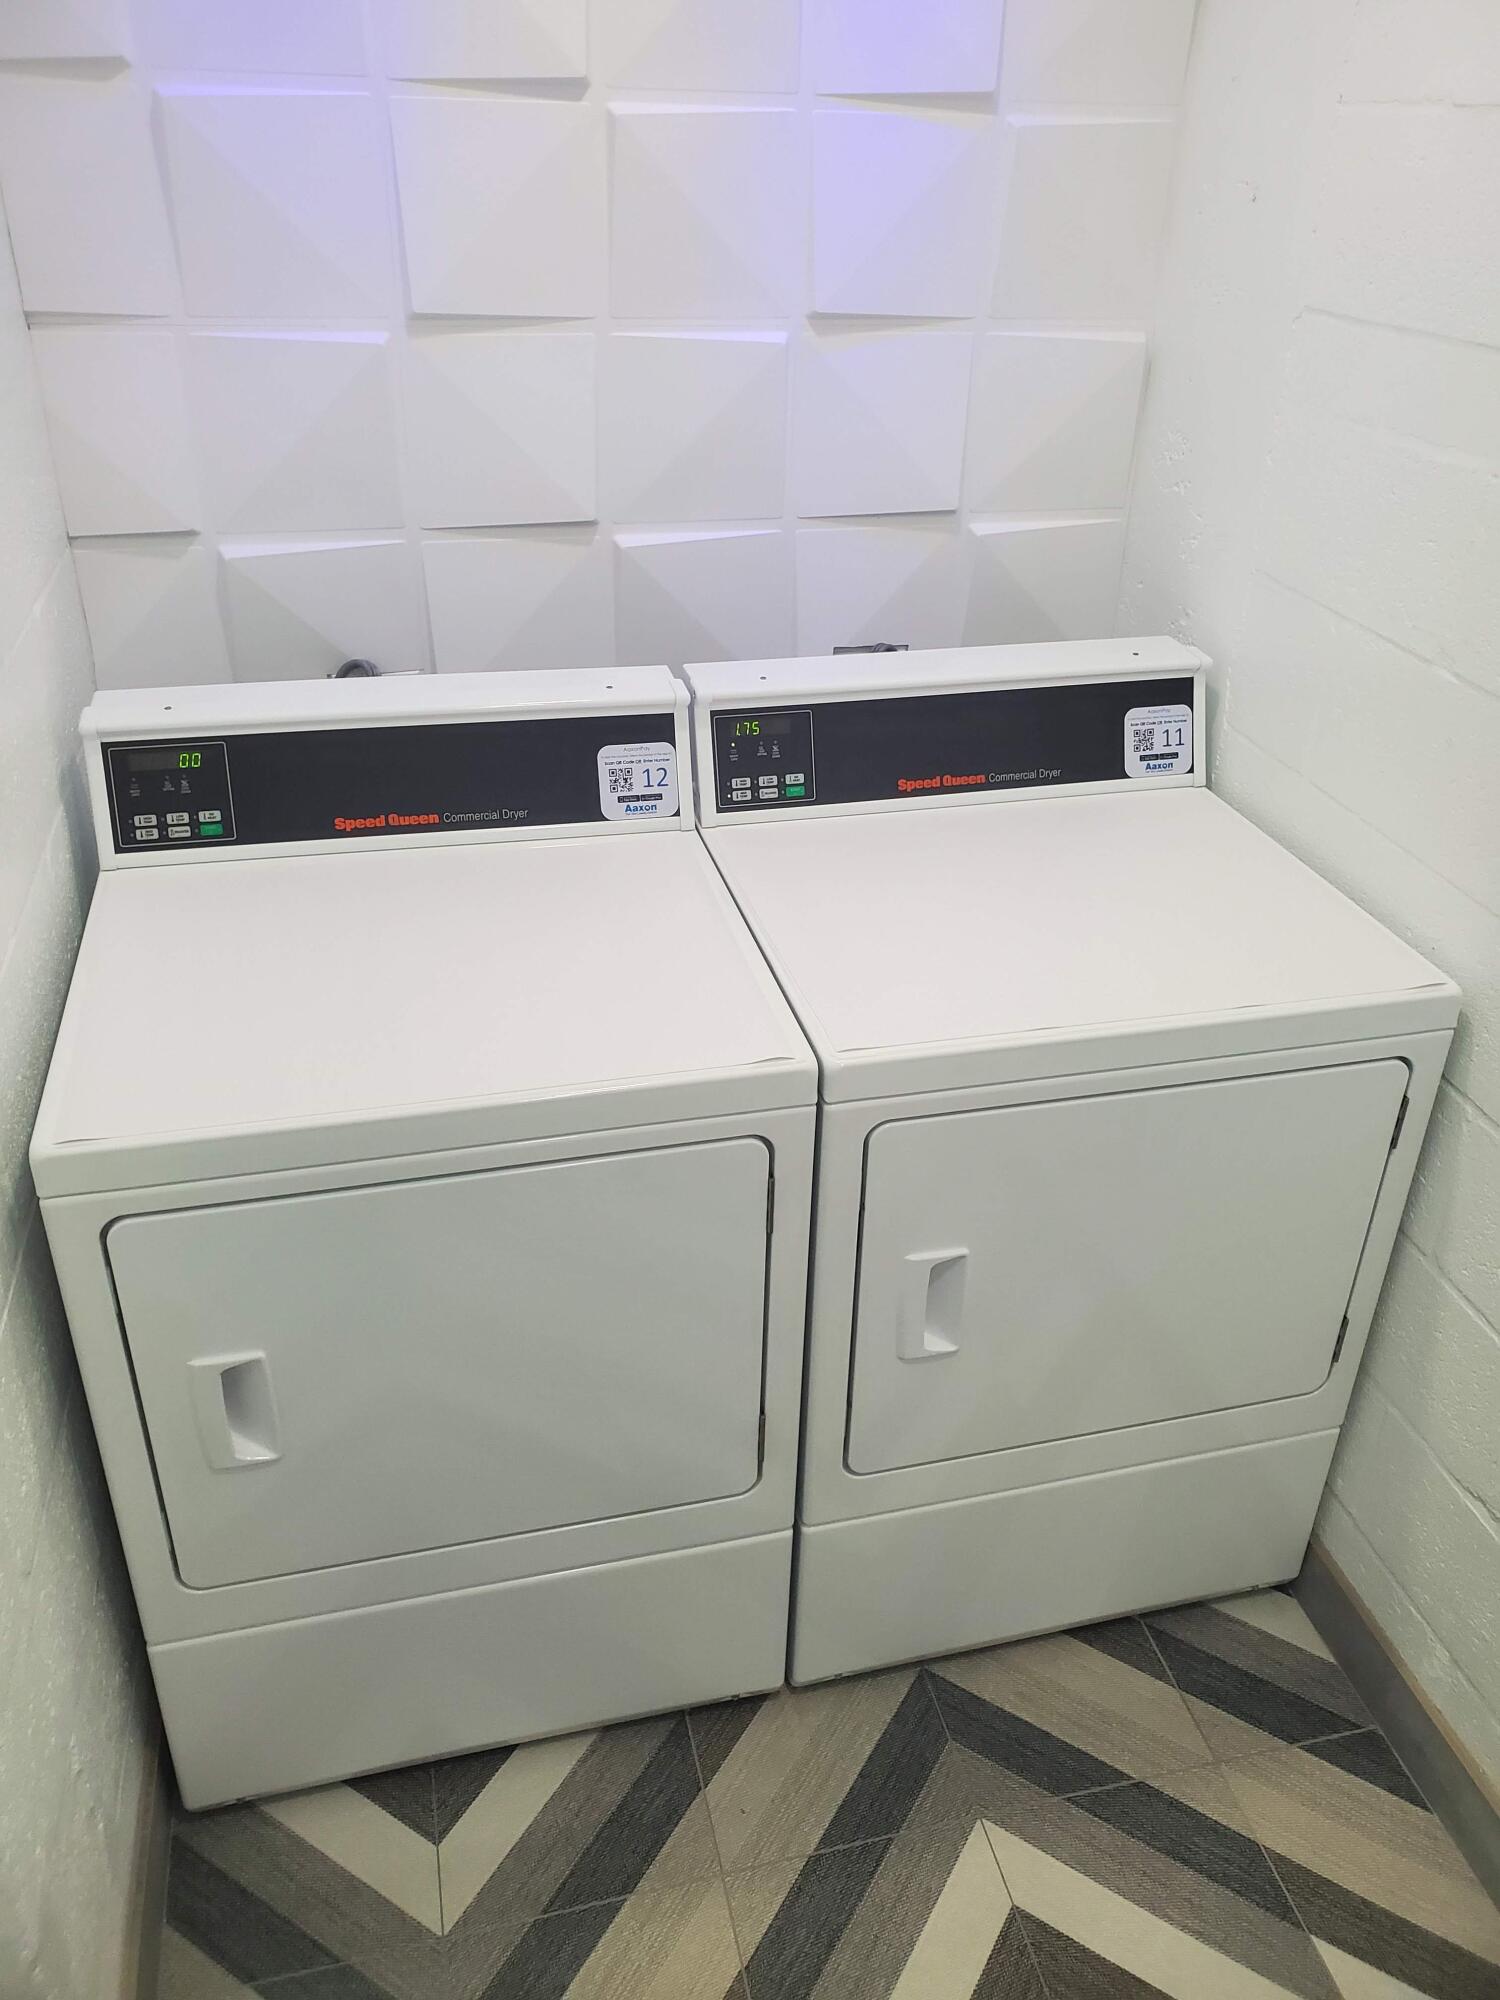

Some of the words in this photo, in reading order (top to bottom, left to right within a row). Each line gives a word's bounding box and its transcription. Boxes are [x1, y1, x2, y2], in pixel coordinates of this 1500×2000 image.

[1162, 727, 1184, 747] 11
[1146, 762, 1174, 770] Aaxon
[642, 767, 668, 788] 12
[897, 776, 940, 792] Speed
[943, 774, 986, 787] Queen
[988, 770, 1037, 782] Commercial
[1039, 768, 1062, 780] Dryer
[624, 804, 657, 812] Aaxon
[334, 814, 386, 832] Speed
[388, 813, 439, 826] Queen
[443, 810, 500, 823] Commercial
[502, 808, 529, 820] Dryer
